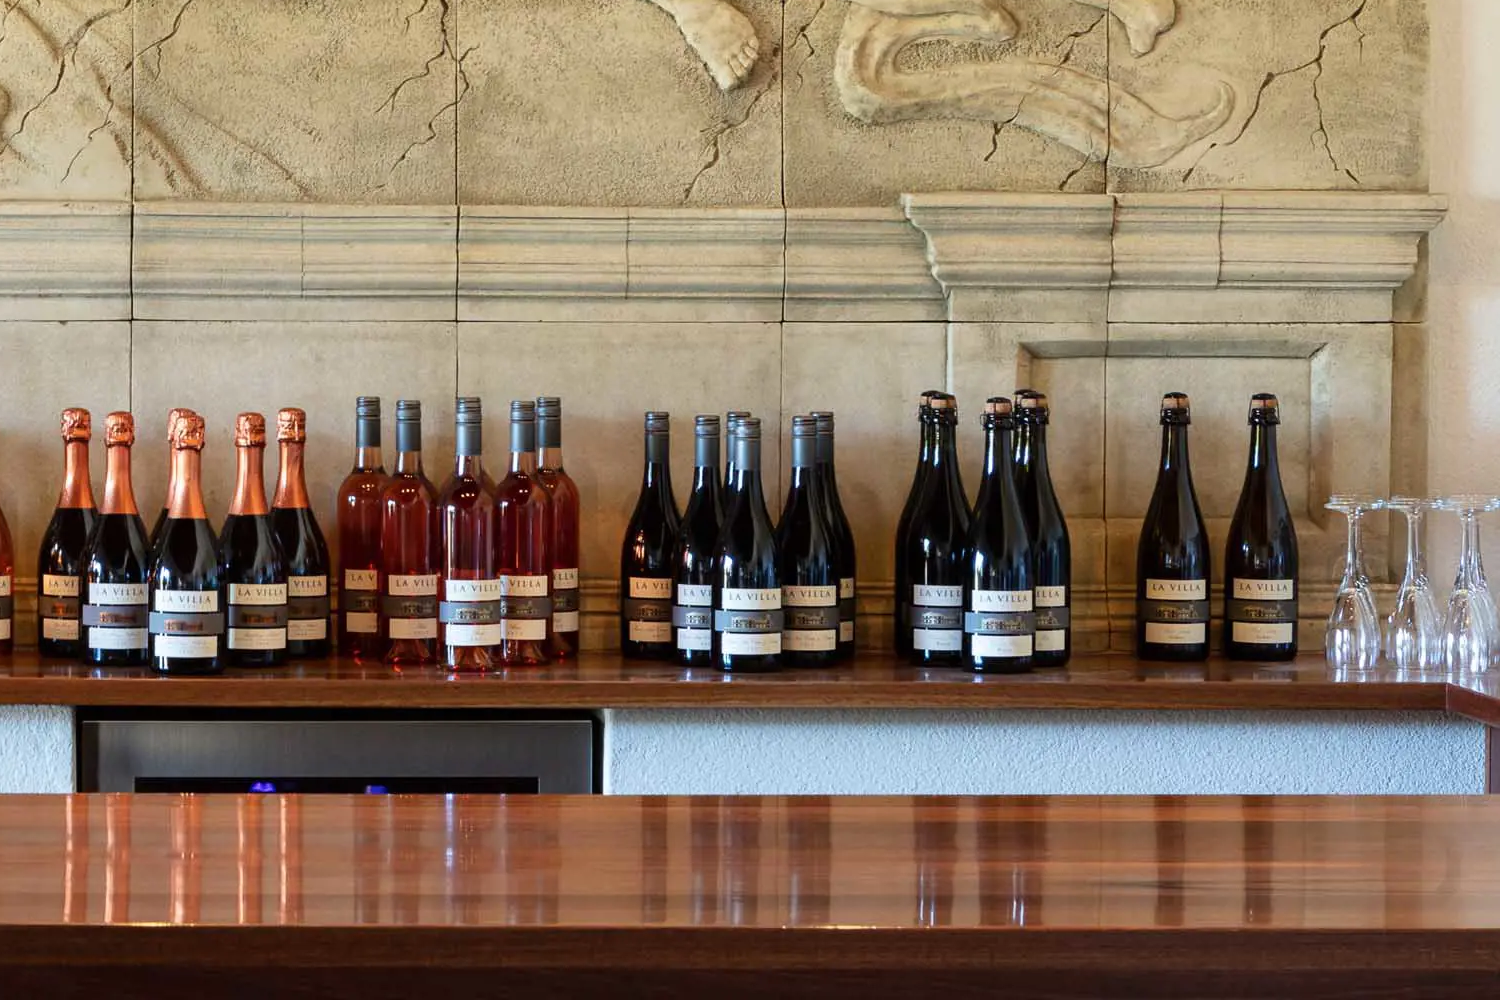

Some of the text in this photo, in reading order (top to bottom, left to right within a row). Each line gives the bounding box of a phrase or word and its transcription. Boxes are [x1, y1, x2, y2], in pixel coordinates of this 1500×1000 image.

[352, 574, 363, 582] LA
[293, 580, 323, 589] VILLA
[396, 579, 436, 587] LA VILL
[509, 580, 541, 588] VILLA
[636, 582, 647, 590] LA
[112, 588, 145, 597] VILLA
[238, 588, 284, 597] LA VILLA
[454, 585, 466, 593] LA
[919, 589, 961, 597] LA VILL
[729, 592, 777, 600] LA VILLA
[800, 591, 831, 599] VILLA
[180, 595, 211, 604] VILLA
